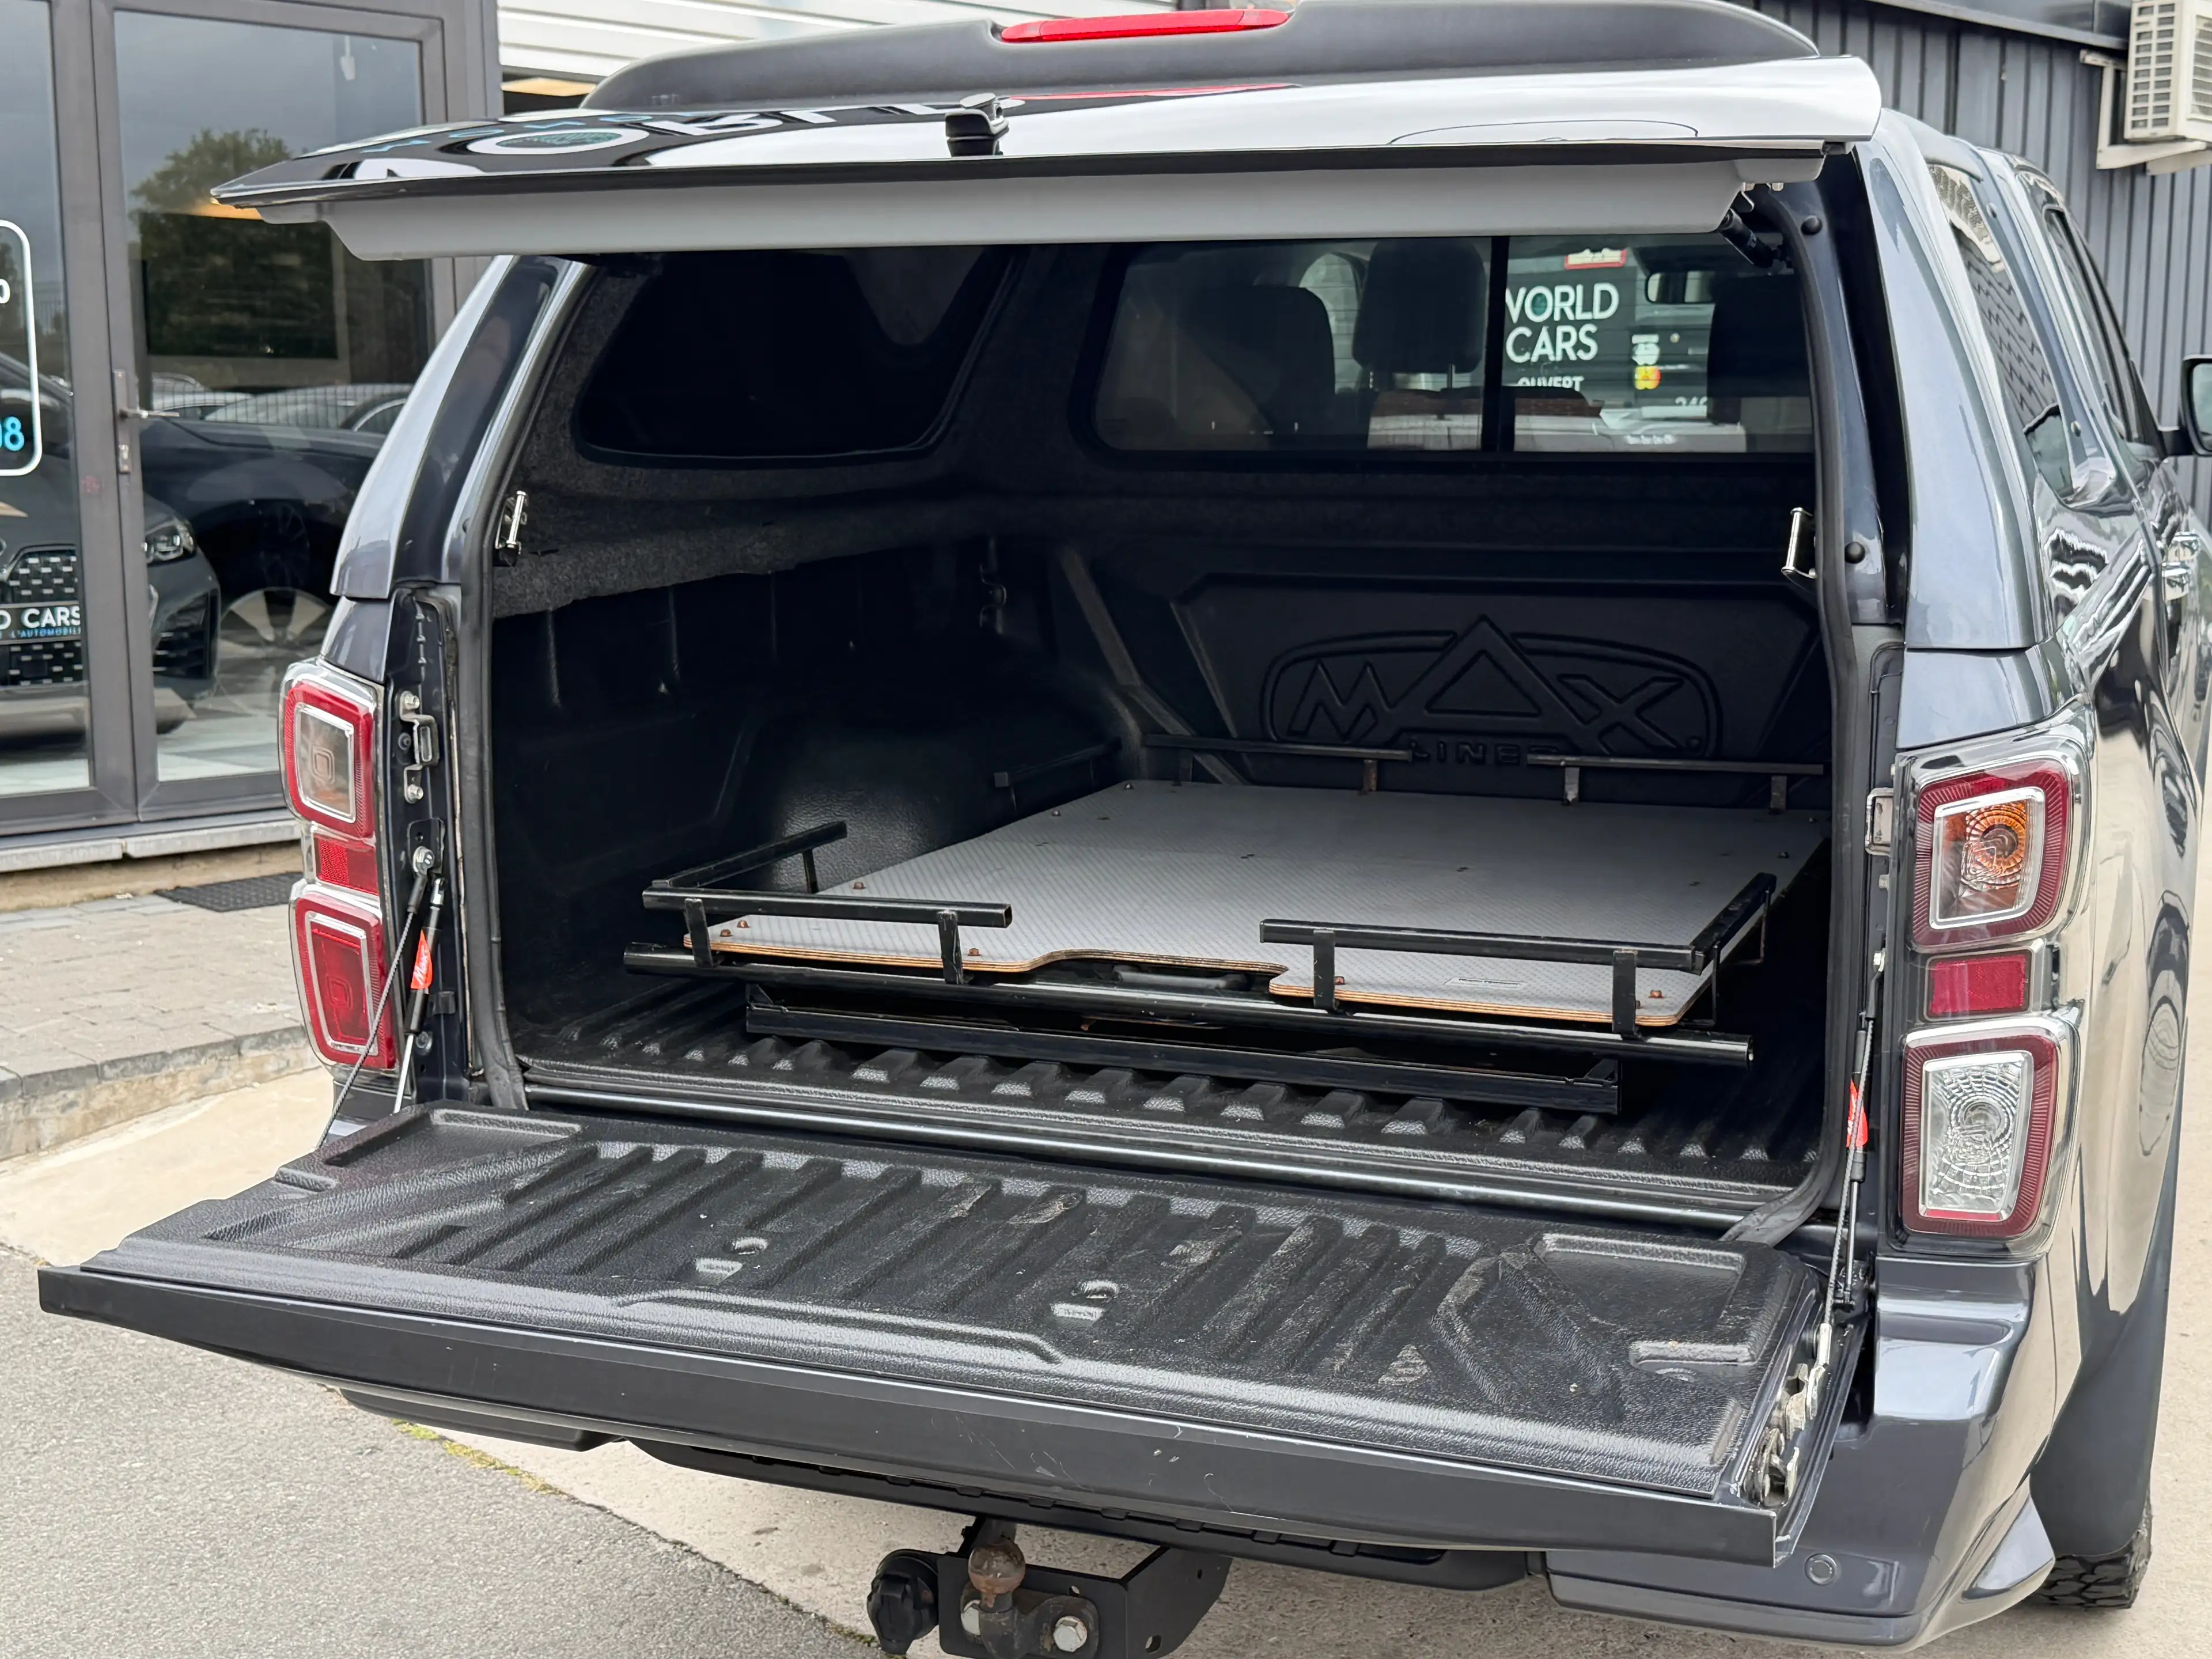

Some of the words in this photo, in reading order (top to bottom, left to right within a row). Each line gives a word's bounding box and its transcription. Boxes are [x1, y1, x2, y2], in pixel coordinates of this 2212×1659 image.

[1506, 323, 1599, 363] CARS
[22, 605, 81, 628] CARS
[1409, 740, 1559, 766] LINE
